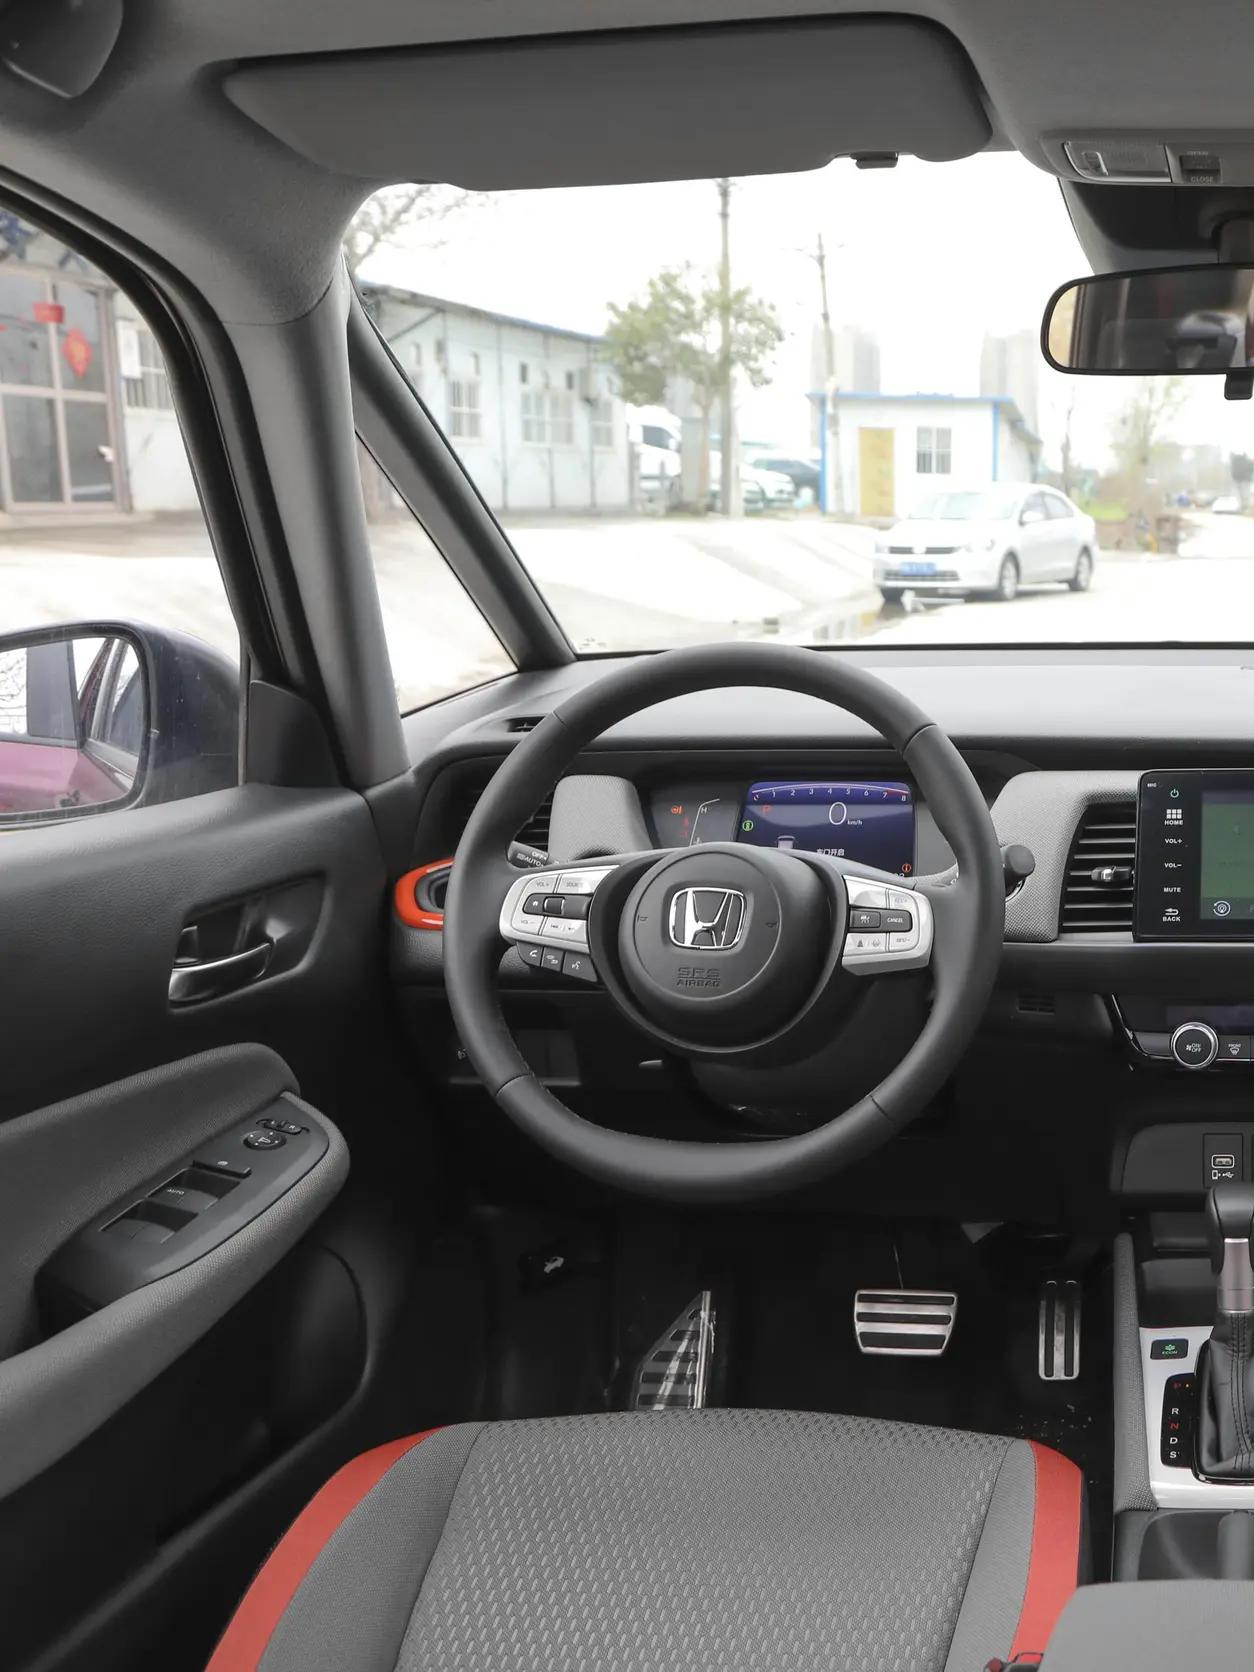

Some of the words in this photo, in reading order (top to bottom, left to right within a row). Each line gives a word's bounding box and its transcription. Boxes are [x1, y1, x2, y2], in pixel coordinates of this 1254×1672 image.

[1190, 176, 1214, 184] CLOSE
[828, 801, 847, 826] 0
[847, 818, 863, 826] km/h
[676, 979, 720, 987] AIRBAG
[1171, 1407, 1179, 1415] R
[1170, 1422, 1179, 1430] N
[1169, 1451, 1177, 1459] S
